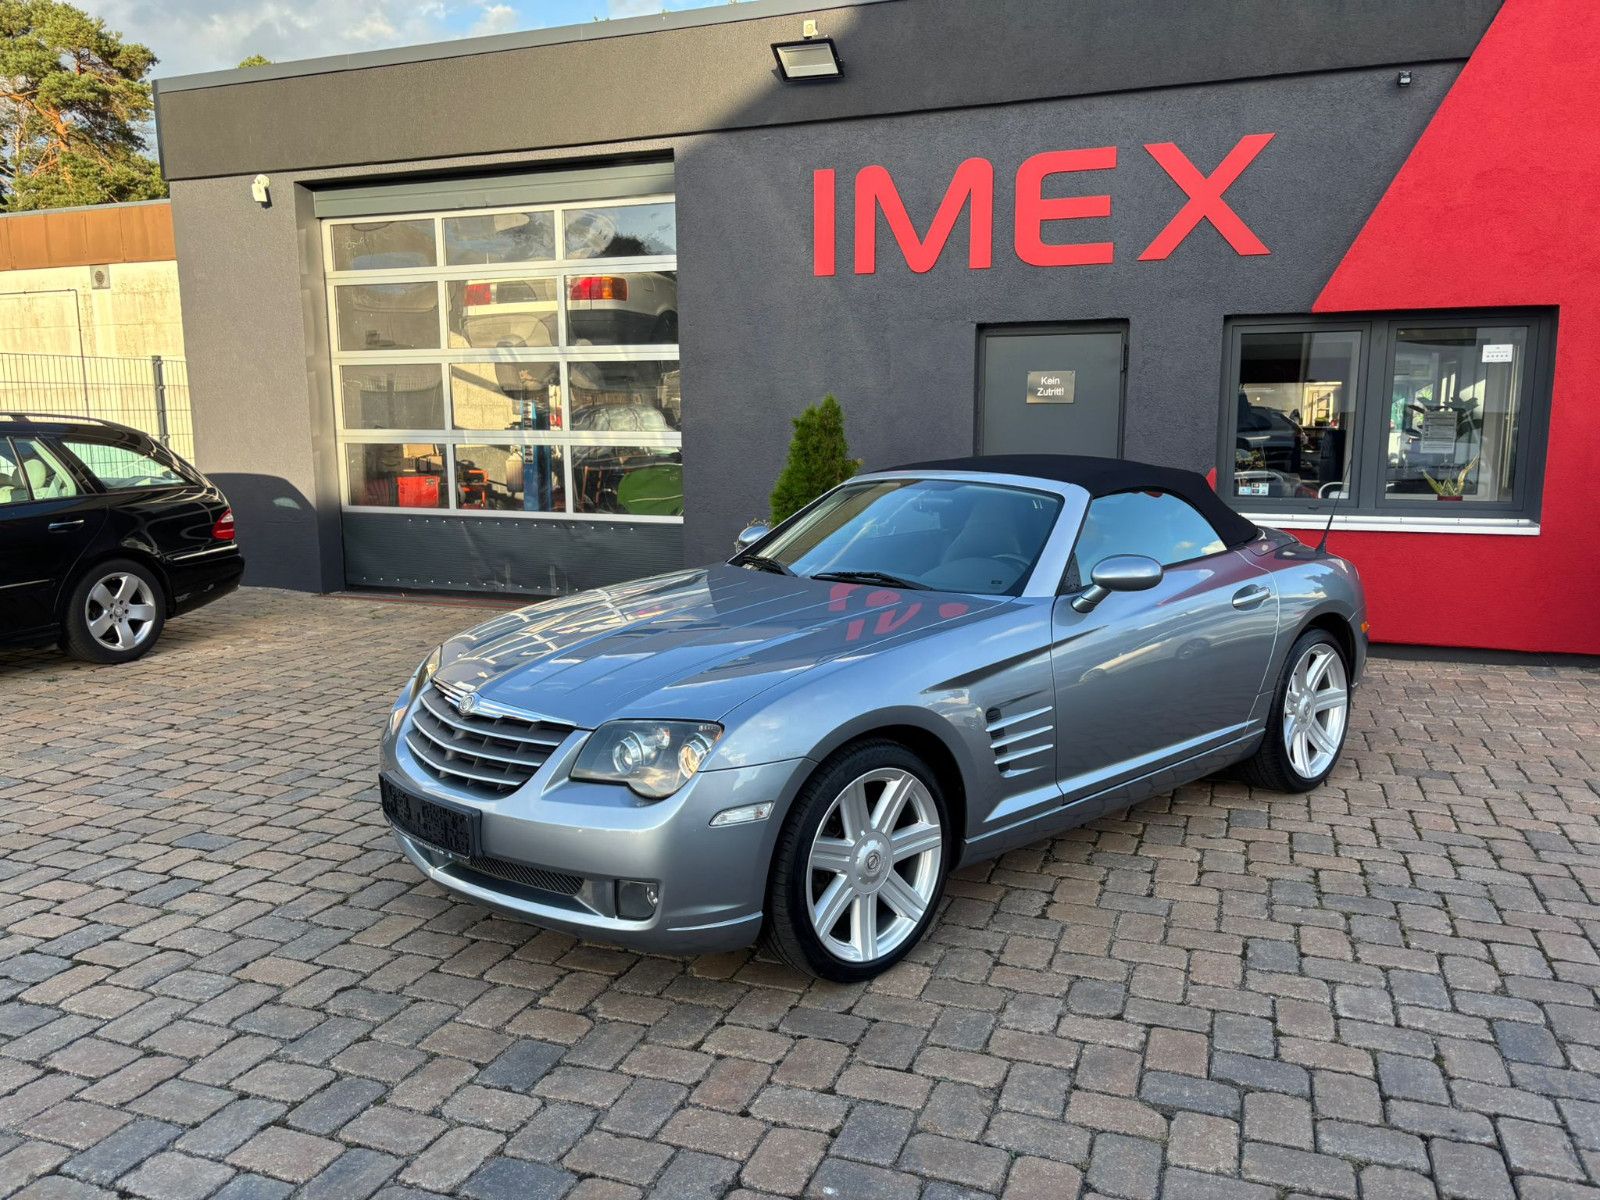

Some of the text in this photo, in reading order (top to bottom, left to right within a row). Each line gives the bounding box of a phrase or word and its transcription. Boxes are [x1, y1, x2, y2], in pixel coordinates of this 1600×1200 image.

[813, 132, 1276, 277] IMEX
[1040, 376, 1061, 385] Kein
[1037, 387, 1064, 396] Zutritt!
